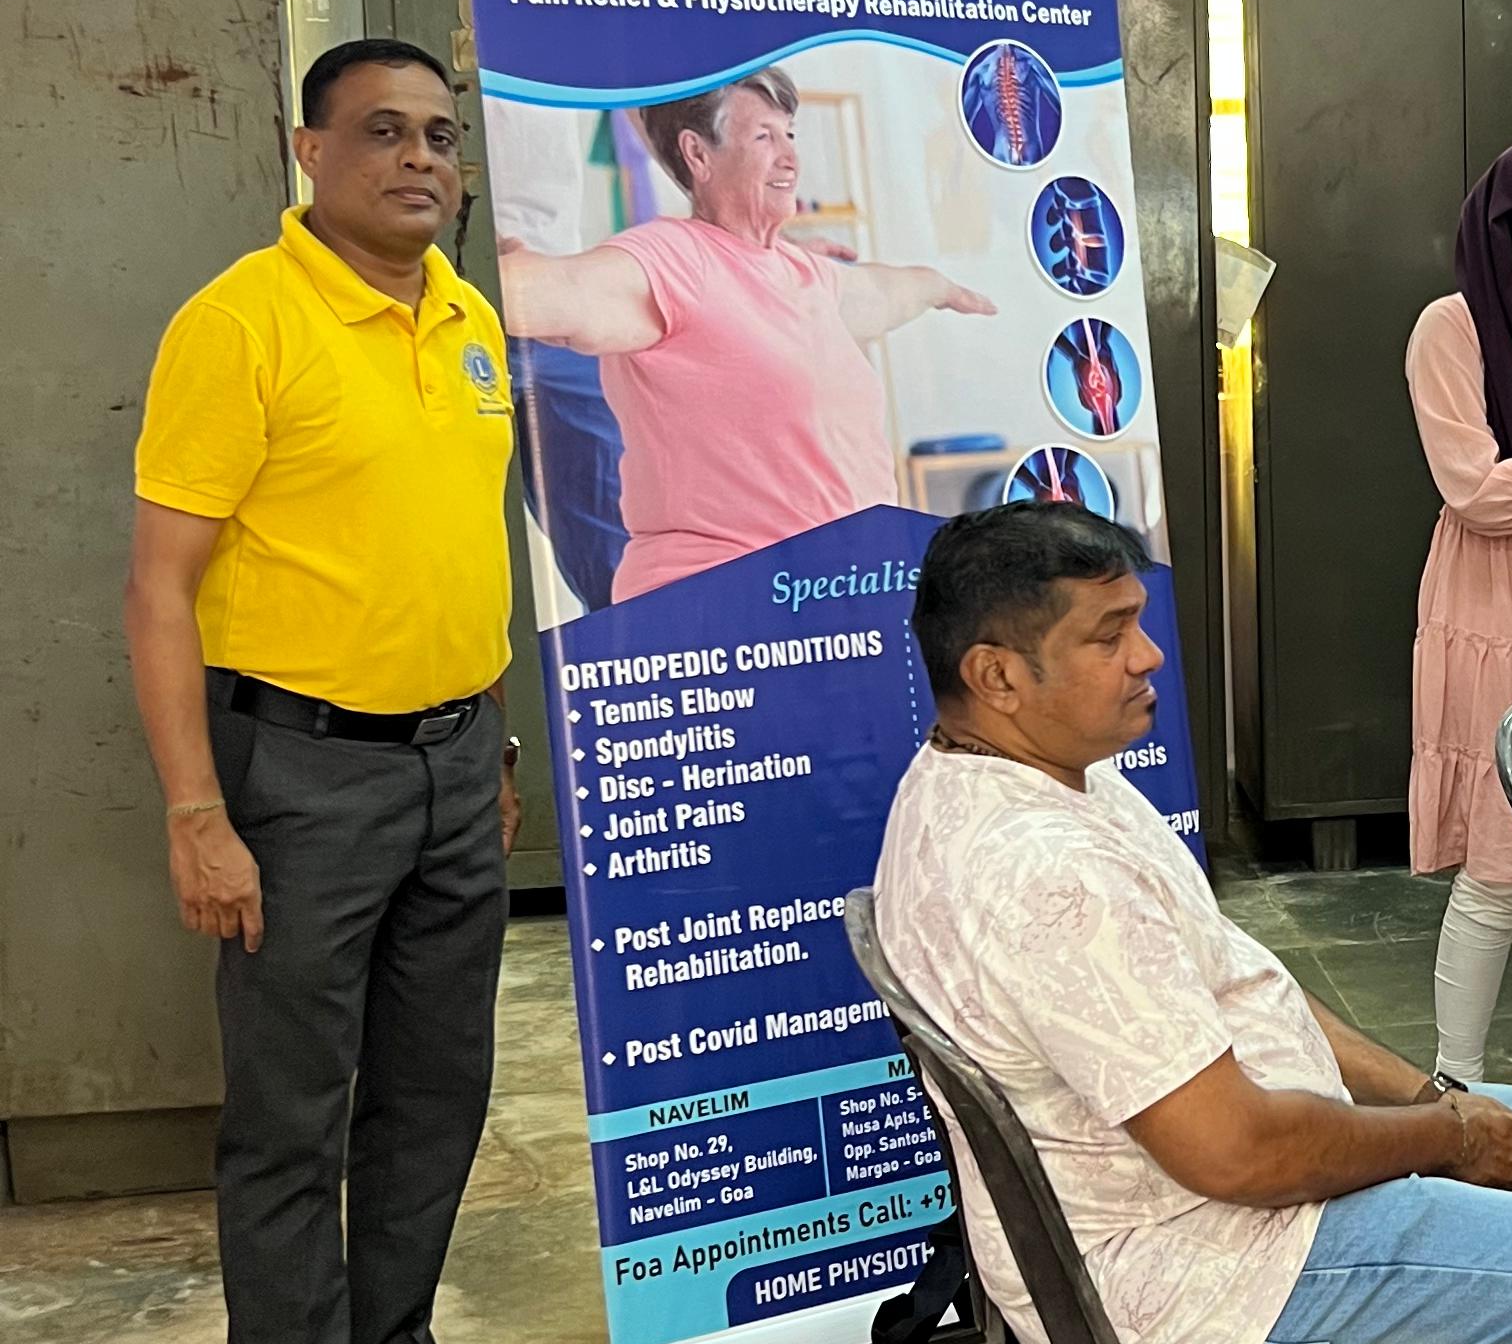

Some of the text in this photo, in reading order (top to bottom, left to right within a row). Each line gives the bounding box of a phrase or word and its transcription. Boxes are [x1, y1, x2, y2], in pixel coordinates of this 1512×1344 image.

[1022, 1, 1091, 25] Center
[560, 631, 882, 690] ORTHOPEDIC CONDITIONS
[590, 688, 754, 725] Tennis Elbow
[596, 724, 735, 768] Spondylitis
[600, 775, 654, 802] Disc
[682, 754, 811, 790] Herination
[604, 800, 744, 840] Joint Pains
[609, 841, 711, 878] Arthritis
[615, 922, 671, 953] Post
[679, 910, 742, 943] Joint
[626, 941, 808, 990] Rehabilitation.
[627, 1034, 682, 1066] Post
[690, 1018, 757, 1054] Covid
[649, 1091, 749, 1127] NAVELIM
[840, 1099, 876, 1115] Shop
[880, 1092, 903, 1106] No.
[843, 1120, 879, 1137] Musa
[845, 1127, 935, 1160] Opp. Santosh
[626, 1135, 732, 1172] Shop No. 29,
[847, 1161, 899, 1181] Margao
[915, 1151, 941, 1165] Goa
[628, 1147, 817, 1198] L&L Odyssey Building,
[631, 1197, 701, 1224] Navelim
[721, 1186, 753, 1203] Goa
[615, 1258, 662, 1286] Foa
[673, 1210, 850, 1275] Appointments
[859, 1193, 912, 1227] Call:
[756, 1268, 821, 1304] HOME
